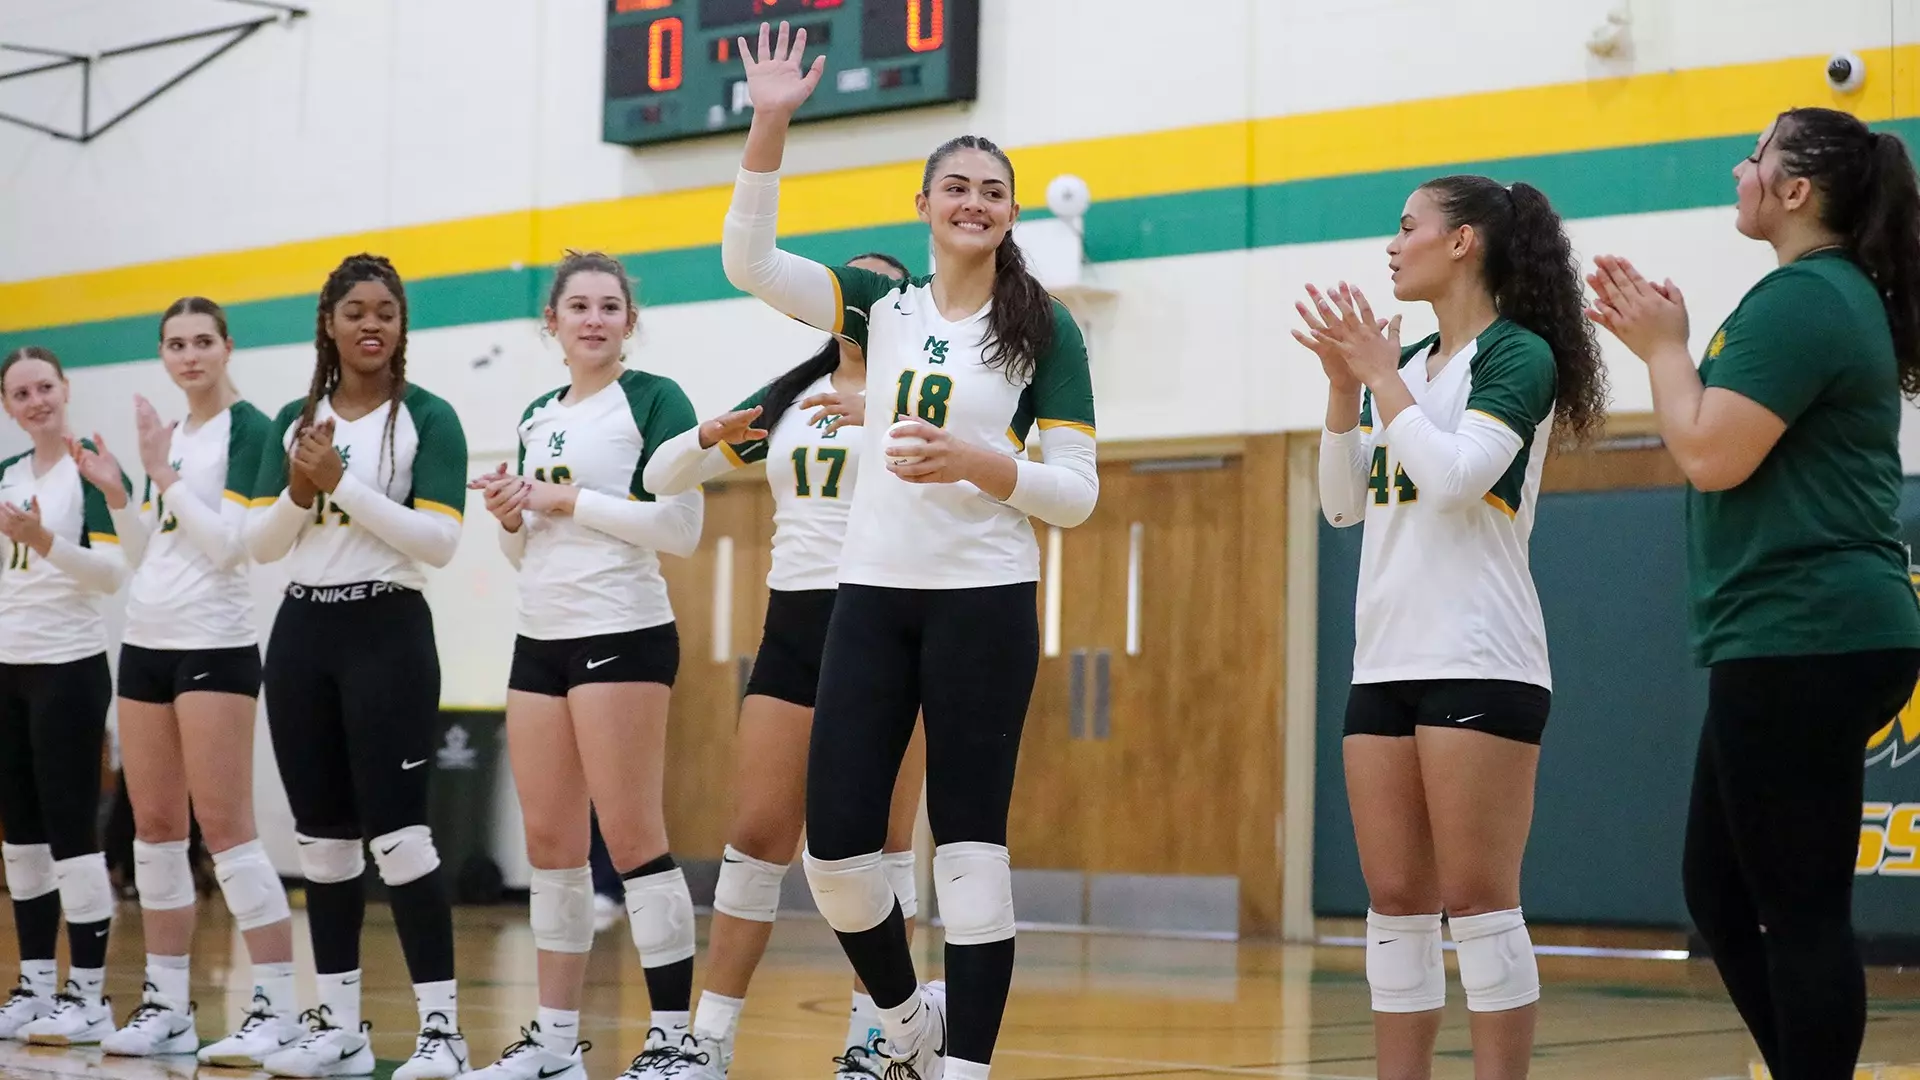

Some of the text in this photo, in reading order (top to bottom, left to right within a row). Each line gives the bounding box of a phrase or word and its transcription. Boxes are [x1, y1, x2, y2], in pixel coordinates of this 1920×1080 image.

[648, 17, 683, 92] 0
[891, 368, 955, 429] 18
[790, 446, 849, 500] 17
[1367, 444, 1420, 507] 44
[310, 584, 368, 603] NIKE
